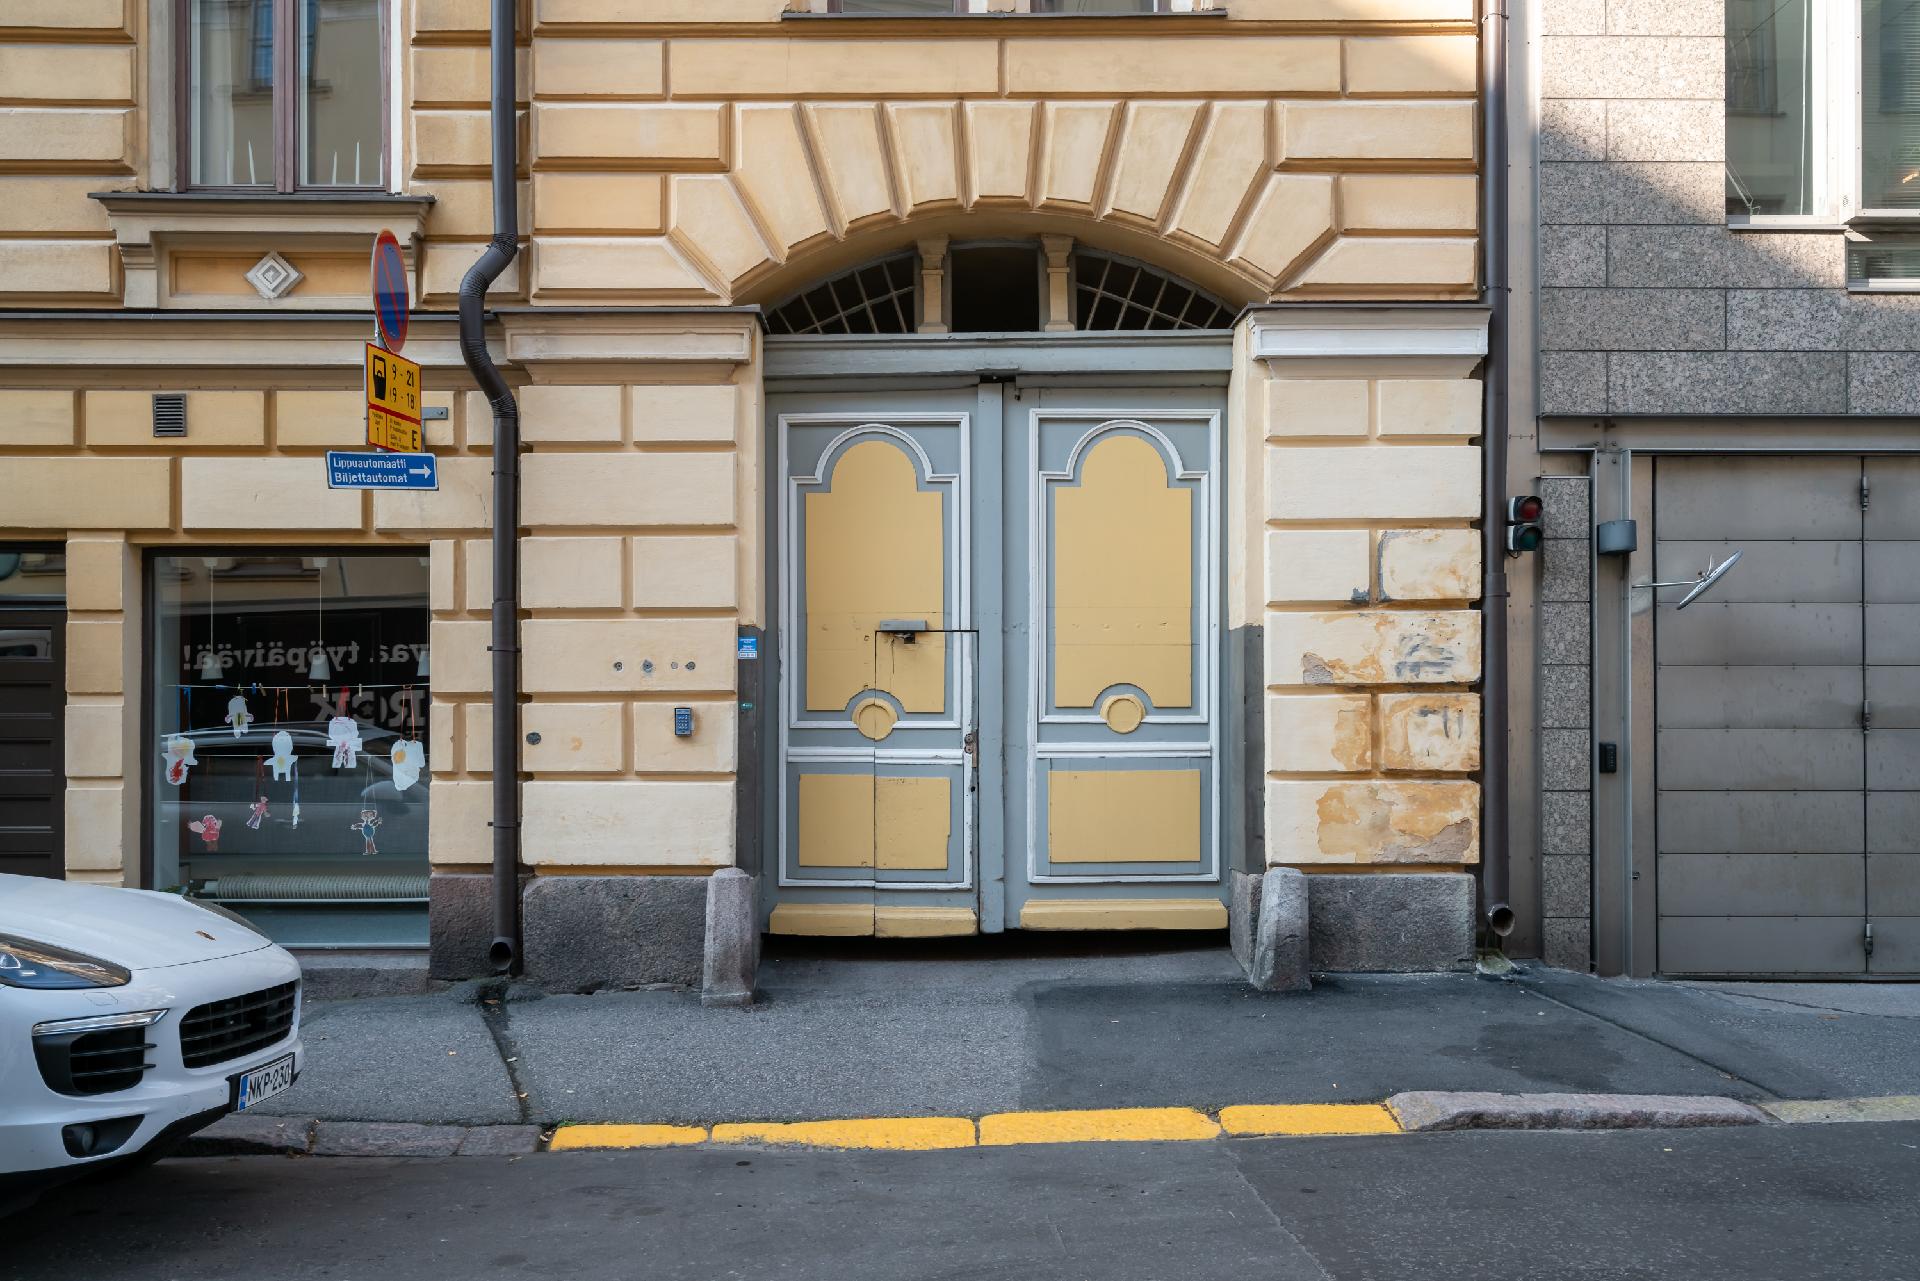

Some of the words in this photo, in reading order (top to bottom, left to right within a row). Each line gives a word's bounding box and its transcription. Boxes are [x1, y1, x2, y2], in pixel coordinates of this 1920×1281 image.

[406, 370, 415, 388] 21
[411, 430, 418, 450] E
[333, 457, 407, 469] Lippuautomaatti
[334, 472, 408, 484] Biljettautomat
[247, 1063, 291, 1102] NKP-230
